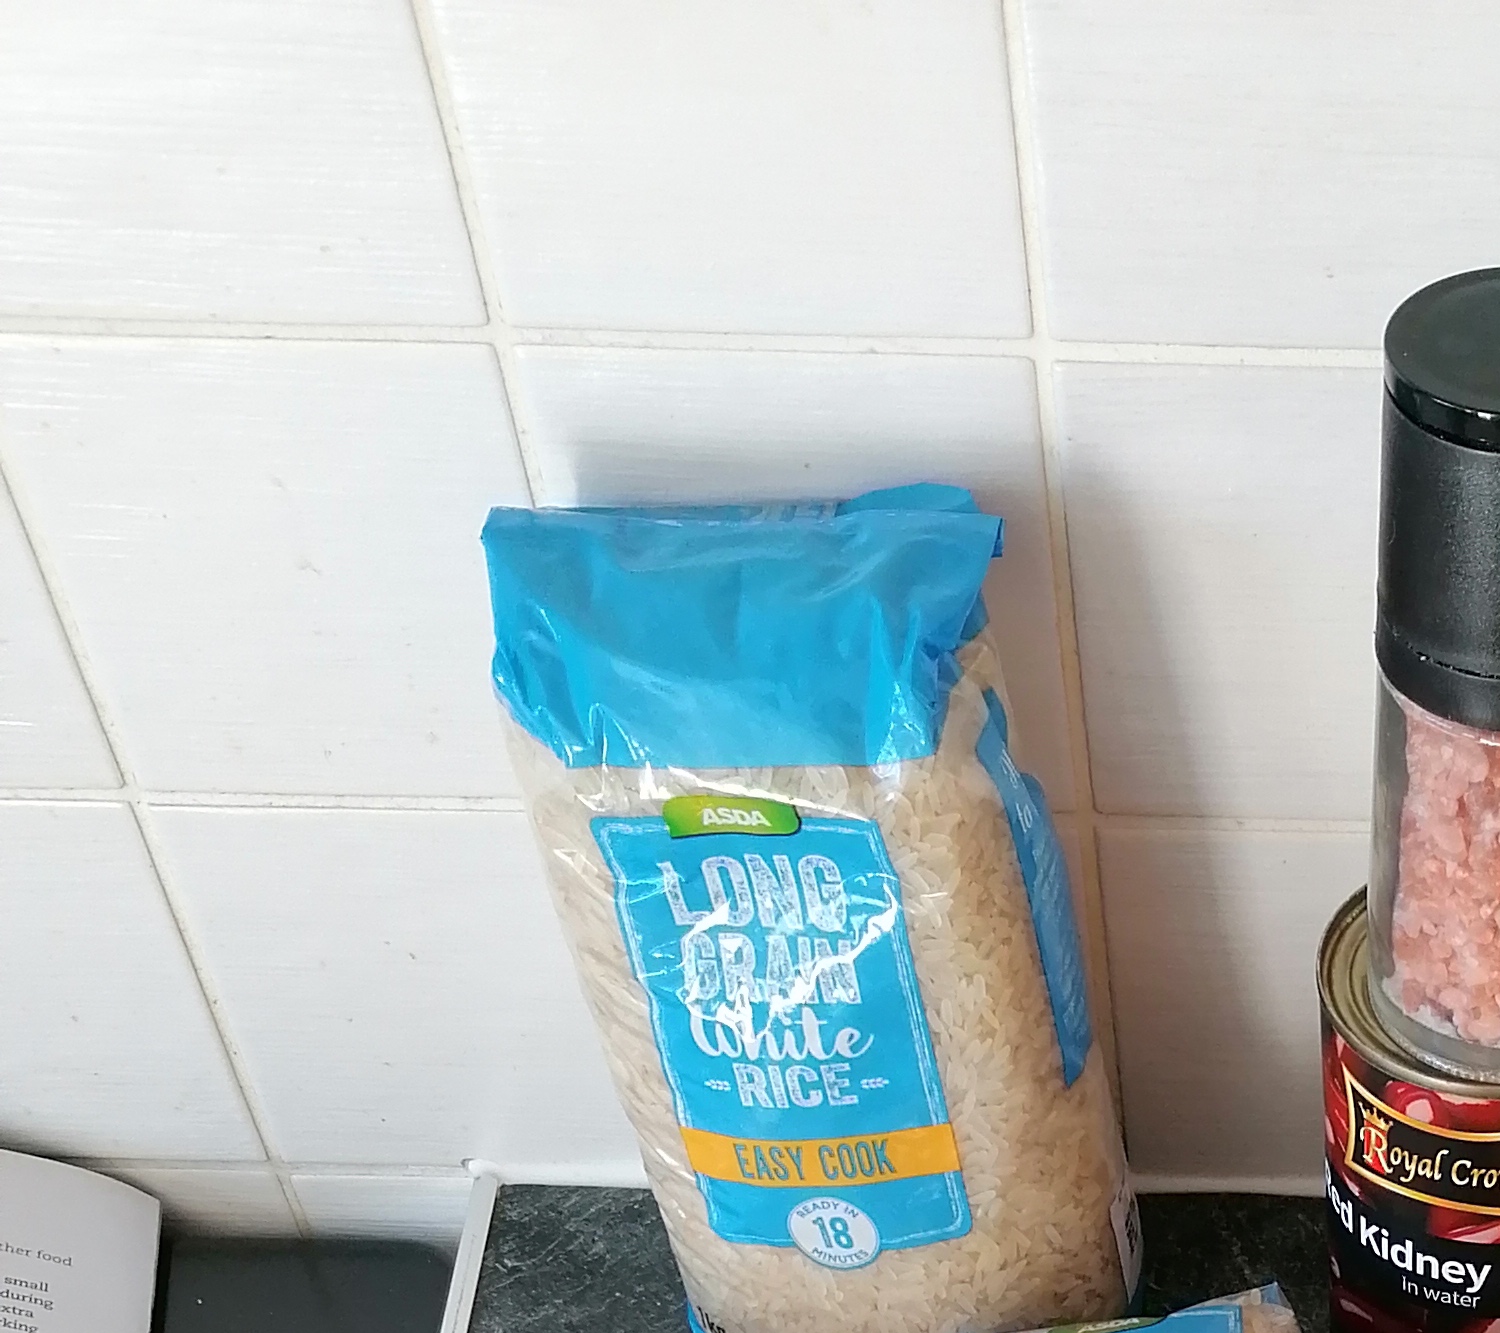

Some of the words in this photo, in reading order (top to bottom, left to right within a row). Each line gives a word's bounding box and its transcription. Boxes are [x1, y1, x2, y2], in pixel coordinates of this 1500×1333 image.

[702, 806, 773, 829] ASDA
[656, 854, 848, 931] LONG
[680, 932, 863, 1005] GRAIN
[690, 1006, 874, 1061] White
[733, 1062, 860, 1109] RICE
[733, 1142, 805, 1181] EASY
[818, 1137, 897, 1180] COOK
[1360, 1121, 1449, 1184] Royal
[796, 1201, 840, 1218] READY
[843, 1206, 860, 1218] IN
[812, 1216, 854, 1249] 18
[37, 1249, 73, 1267] food
[811, 1247, 870, 1264] MINUTES
[1359, 1213, 1492, 1294] Kidney
[0, 1289, 54, 1311] during
[4, 1276, 49, 1293] small
[1423, 1286, 1482, 1310] water
